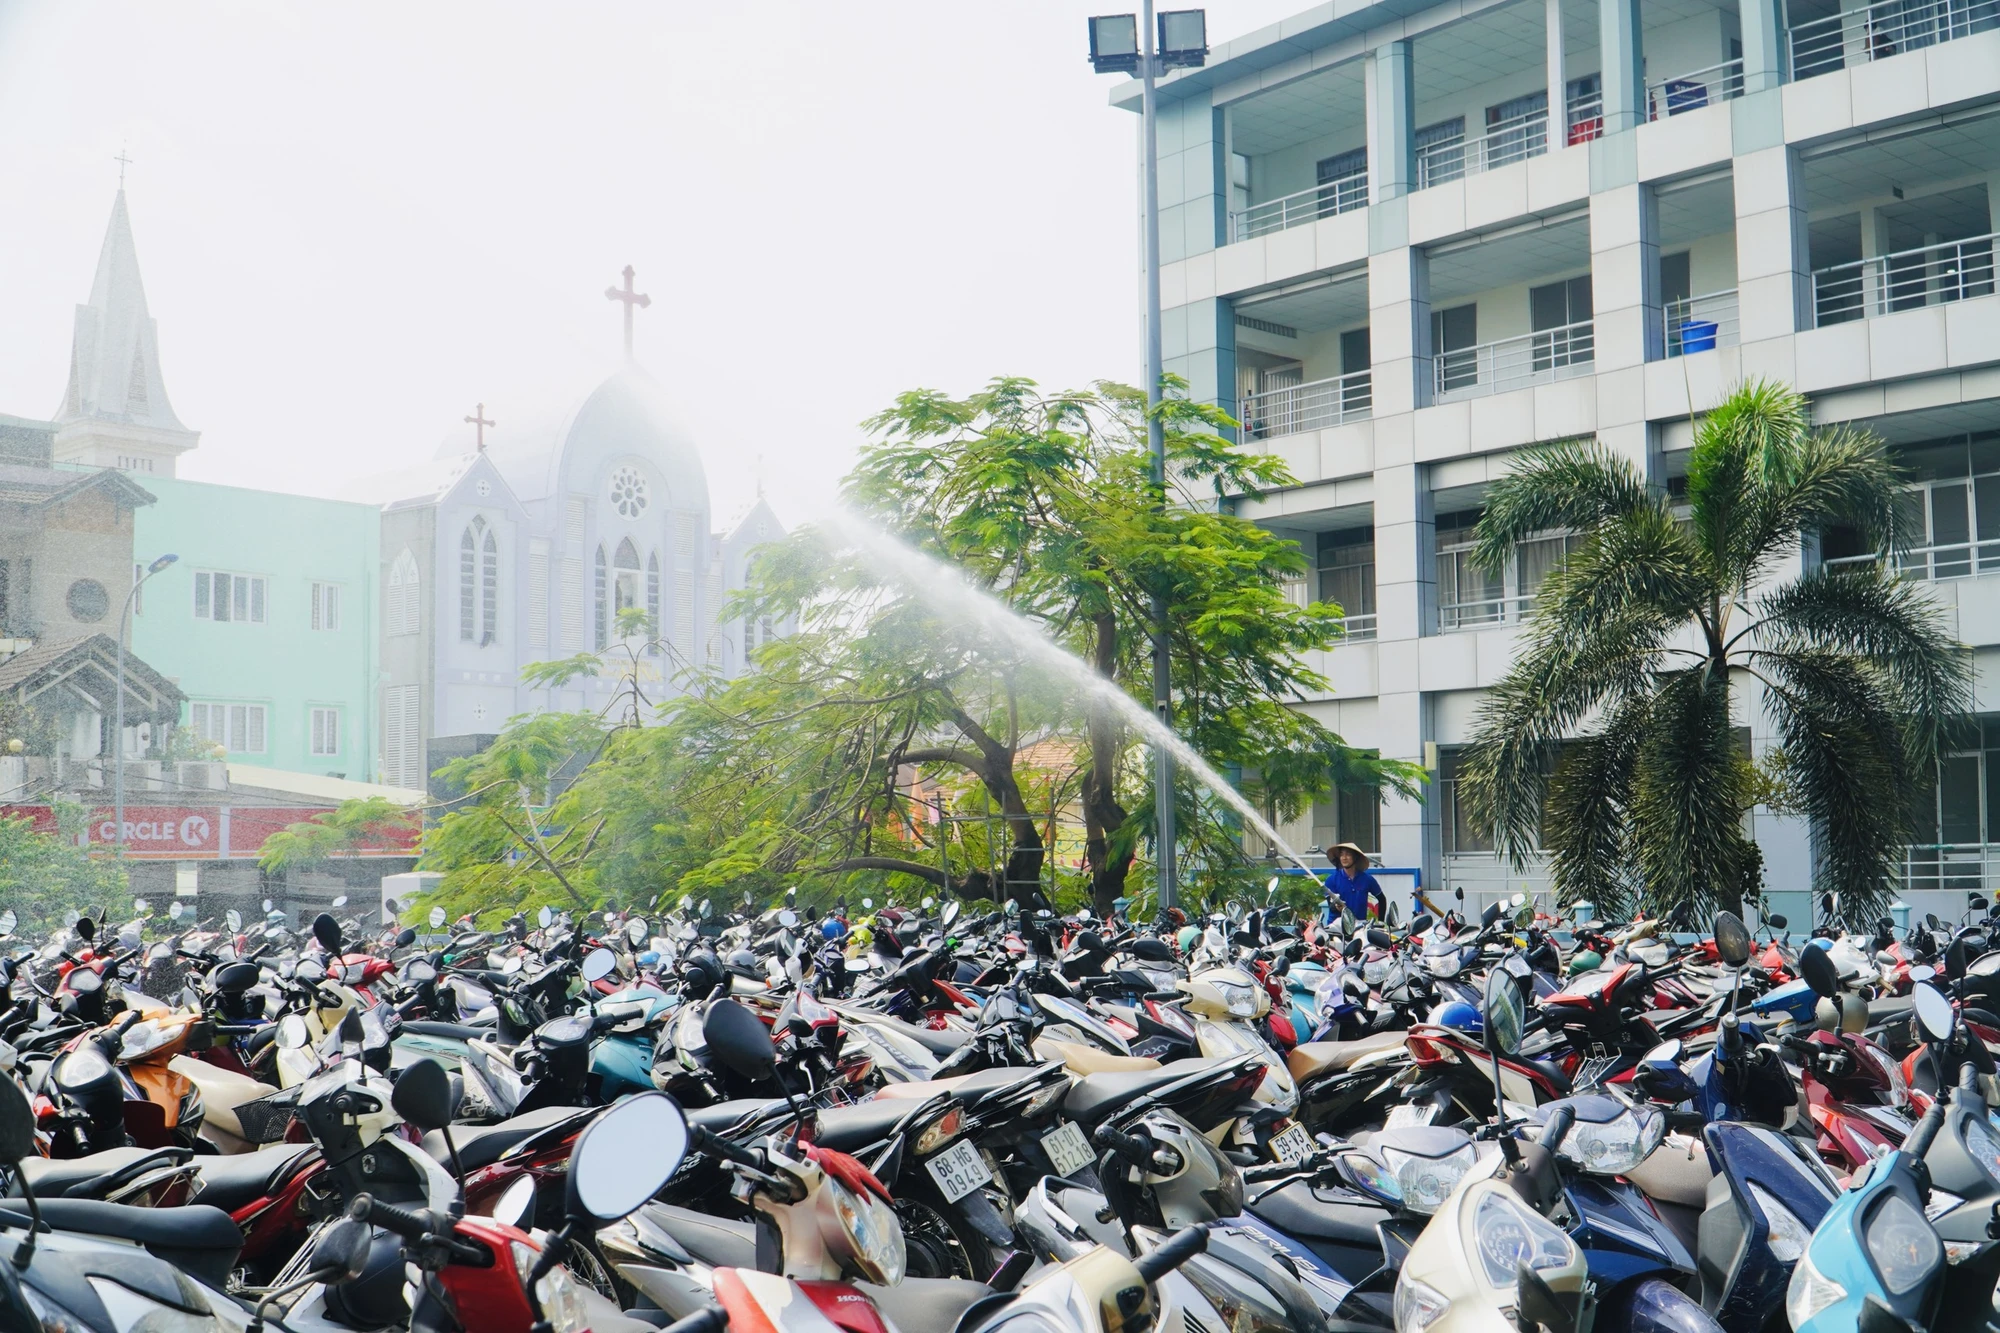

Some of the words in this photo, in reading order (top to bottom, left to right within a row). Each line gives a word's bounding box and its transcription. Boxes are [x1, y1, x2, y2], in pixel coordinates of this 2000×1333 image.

[100, 821, 175, 840] CRCLE
[182, 817, 208, 845] K
[1275, 1128, 1305, 1155] 59-V3
[1055, 1143, 1093, 1174] 512.18
[946, 1164, 984, 1196] 0949
